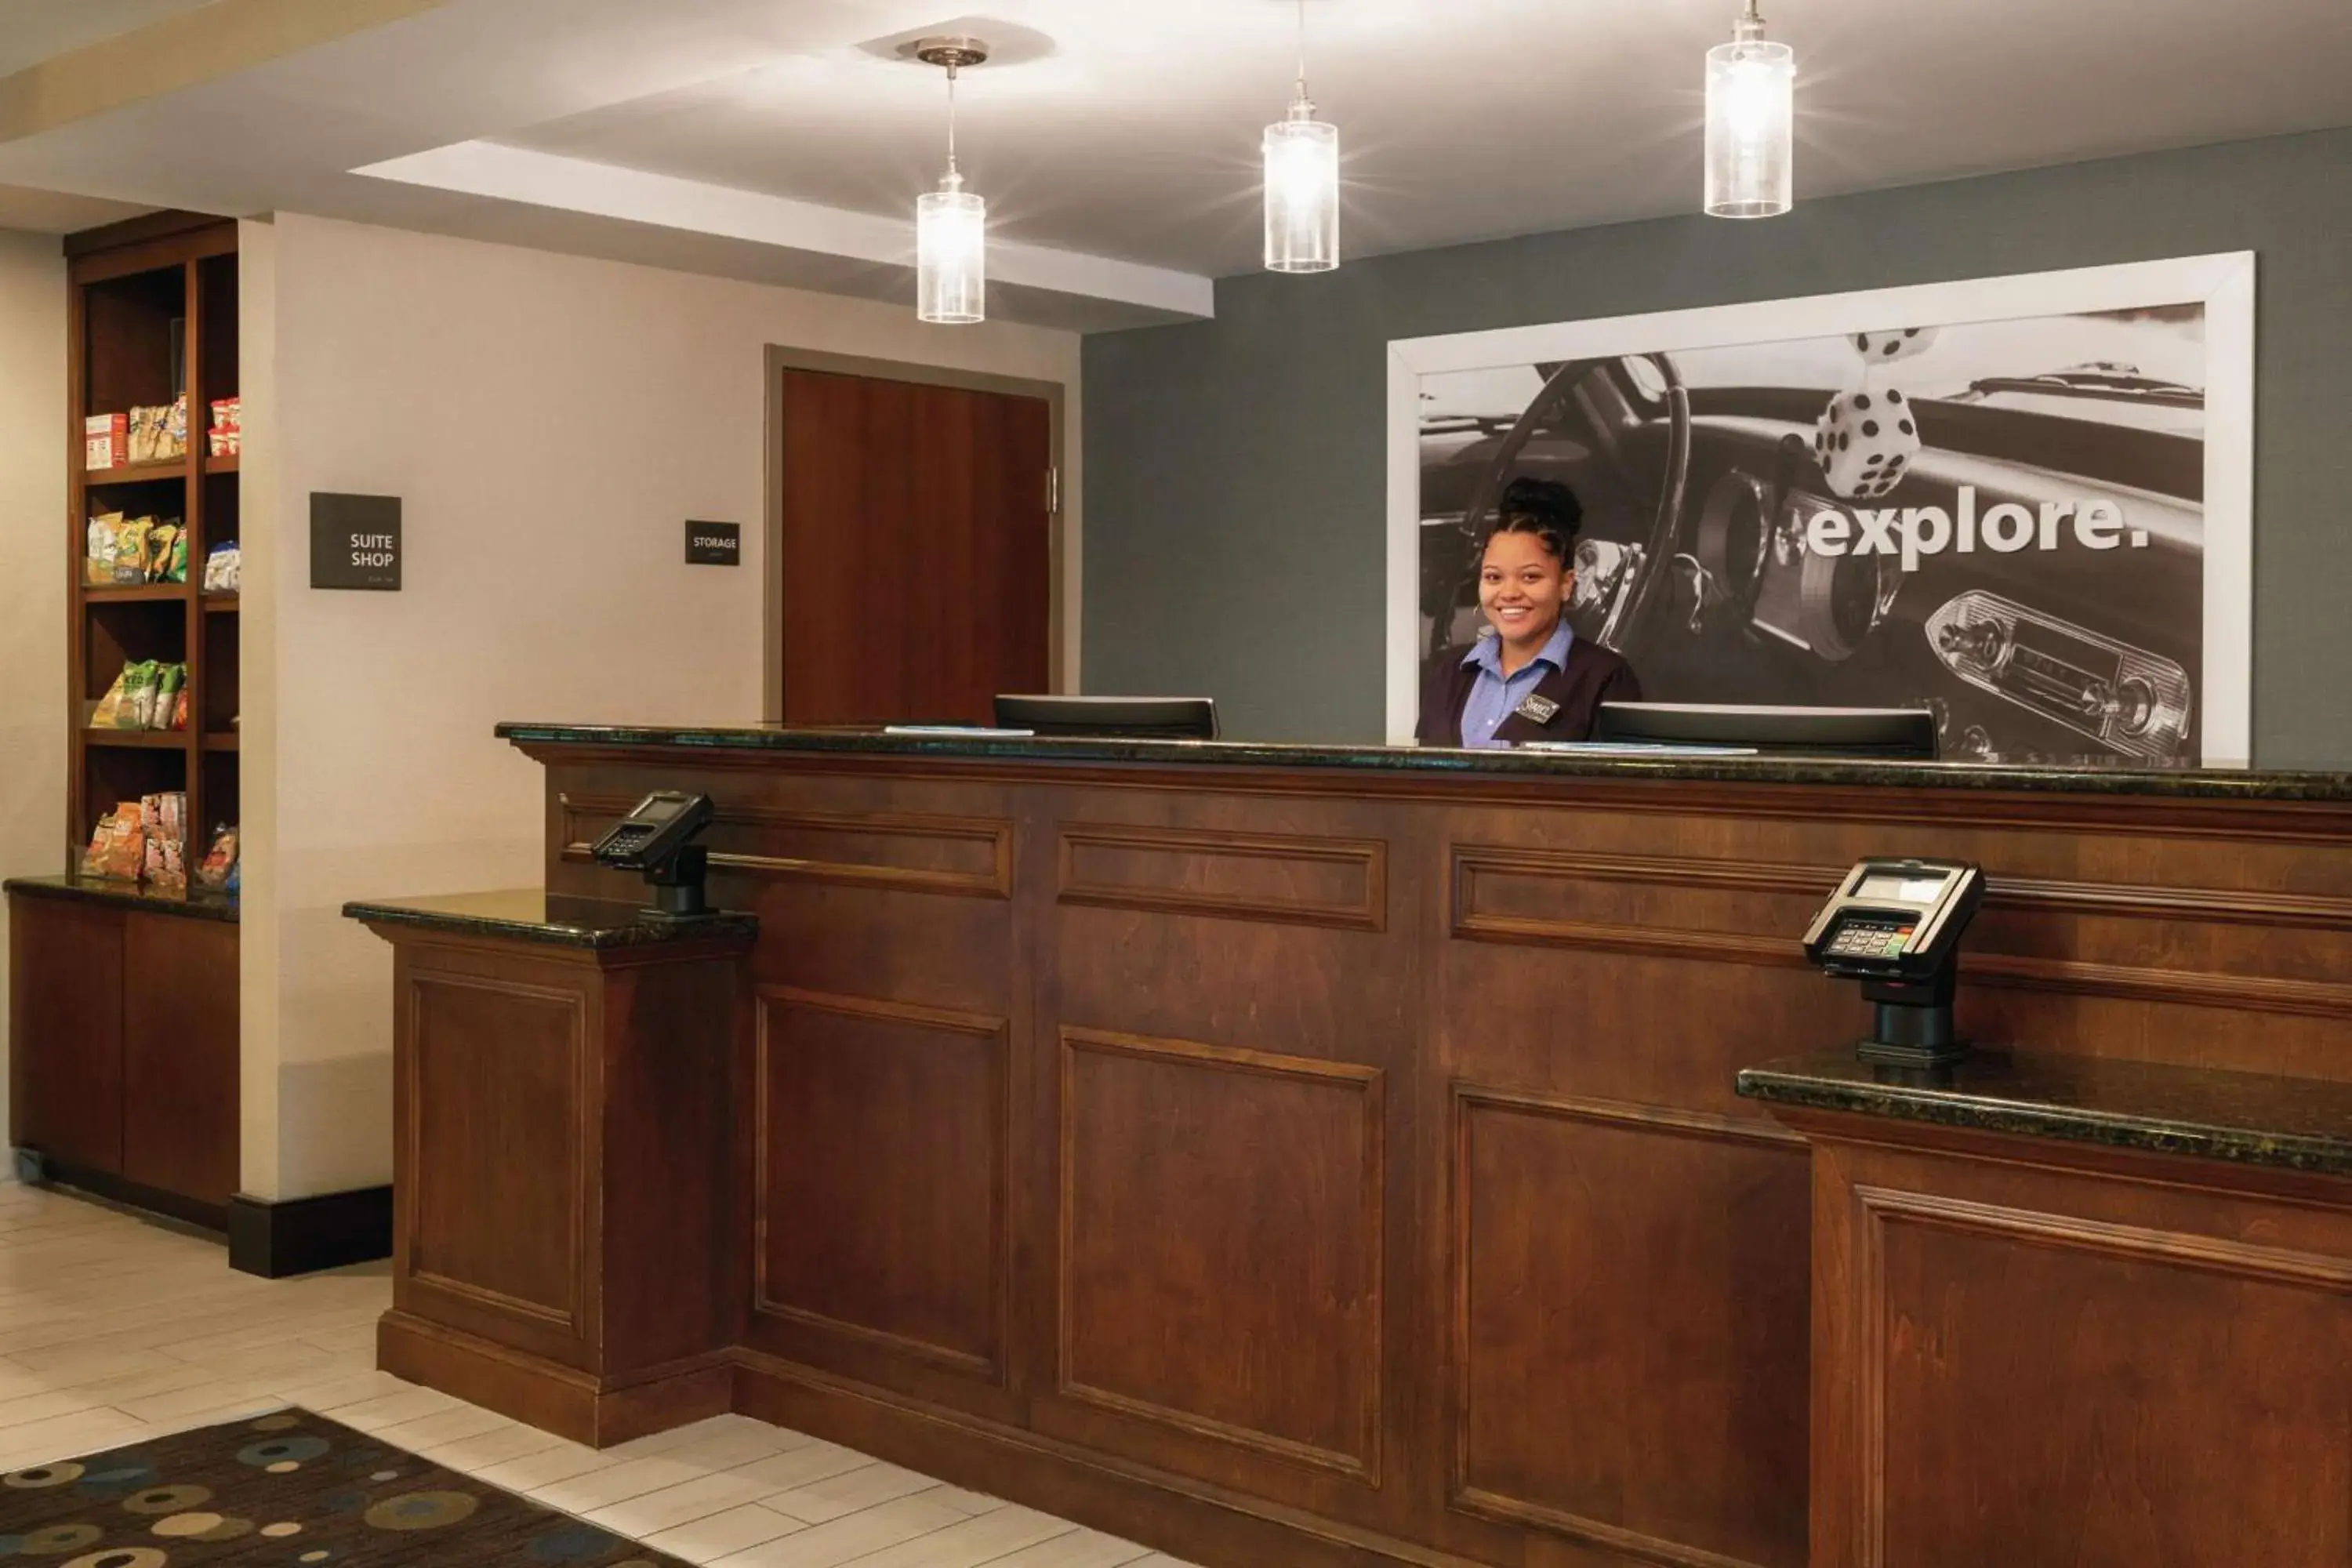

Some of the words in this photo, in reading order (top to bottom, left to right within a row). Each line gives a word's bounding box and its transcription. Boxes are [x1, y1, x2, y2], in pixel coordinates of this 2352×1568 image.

[1806, 485, 2148, 572] explore.
[350, 534, 393, 549] SUITE
[693, 537, 737, 549] STORAGE
[351, 552, 394, 567] SHOP
